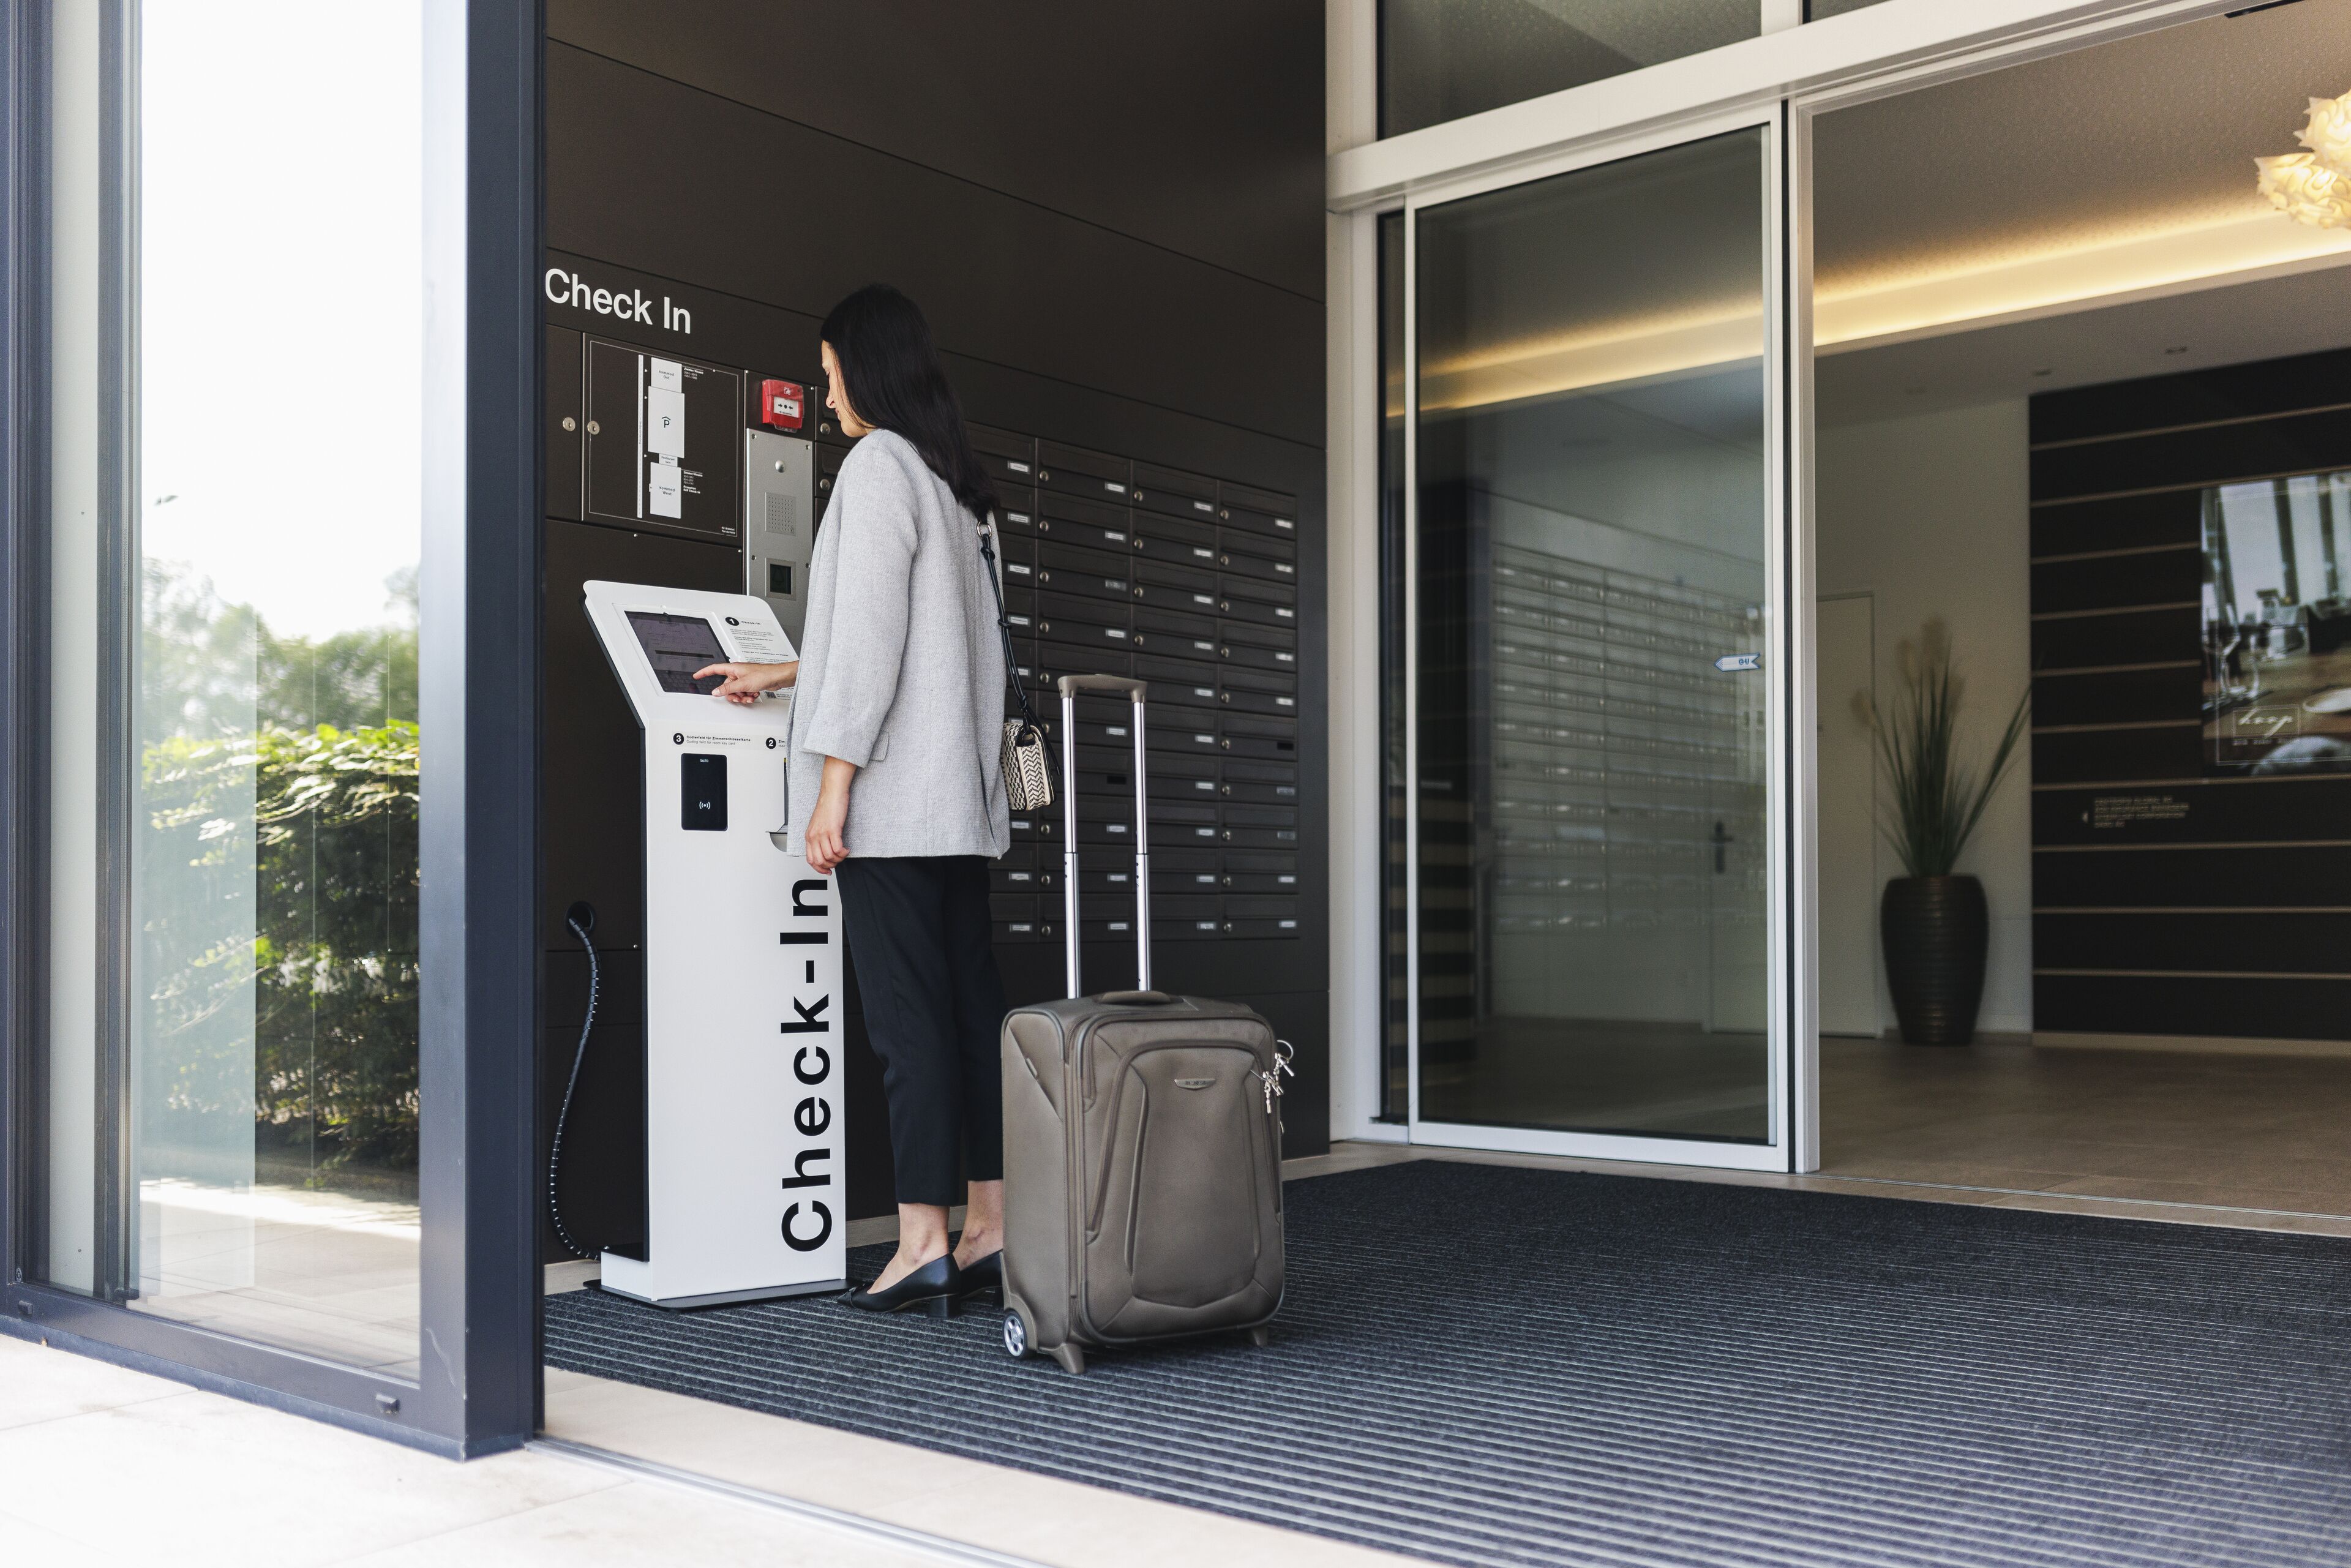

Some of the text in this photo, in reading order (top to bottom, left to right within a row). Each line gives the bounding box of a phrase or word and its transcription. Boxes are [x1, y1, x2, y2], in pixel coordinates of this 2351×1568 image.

[546, 268, 691, 334] Check In
[779, 879, 832, 1252] Check-In
